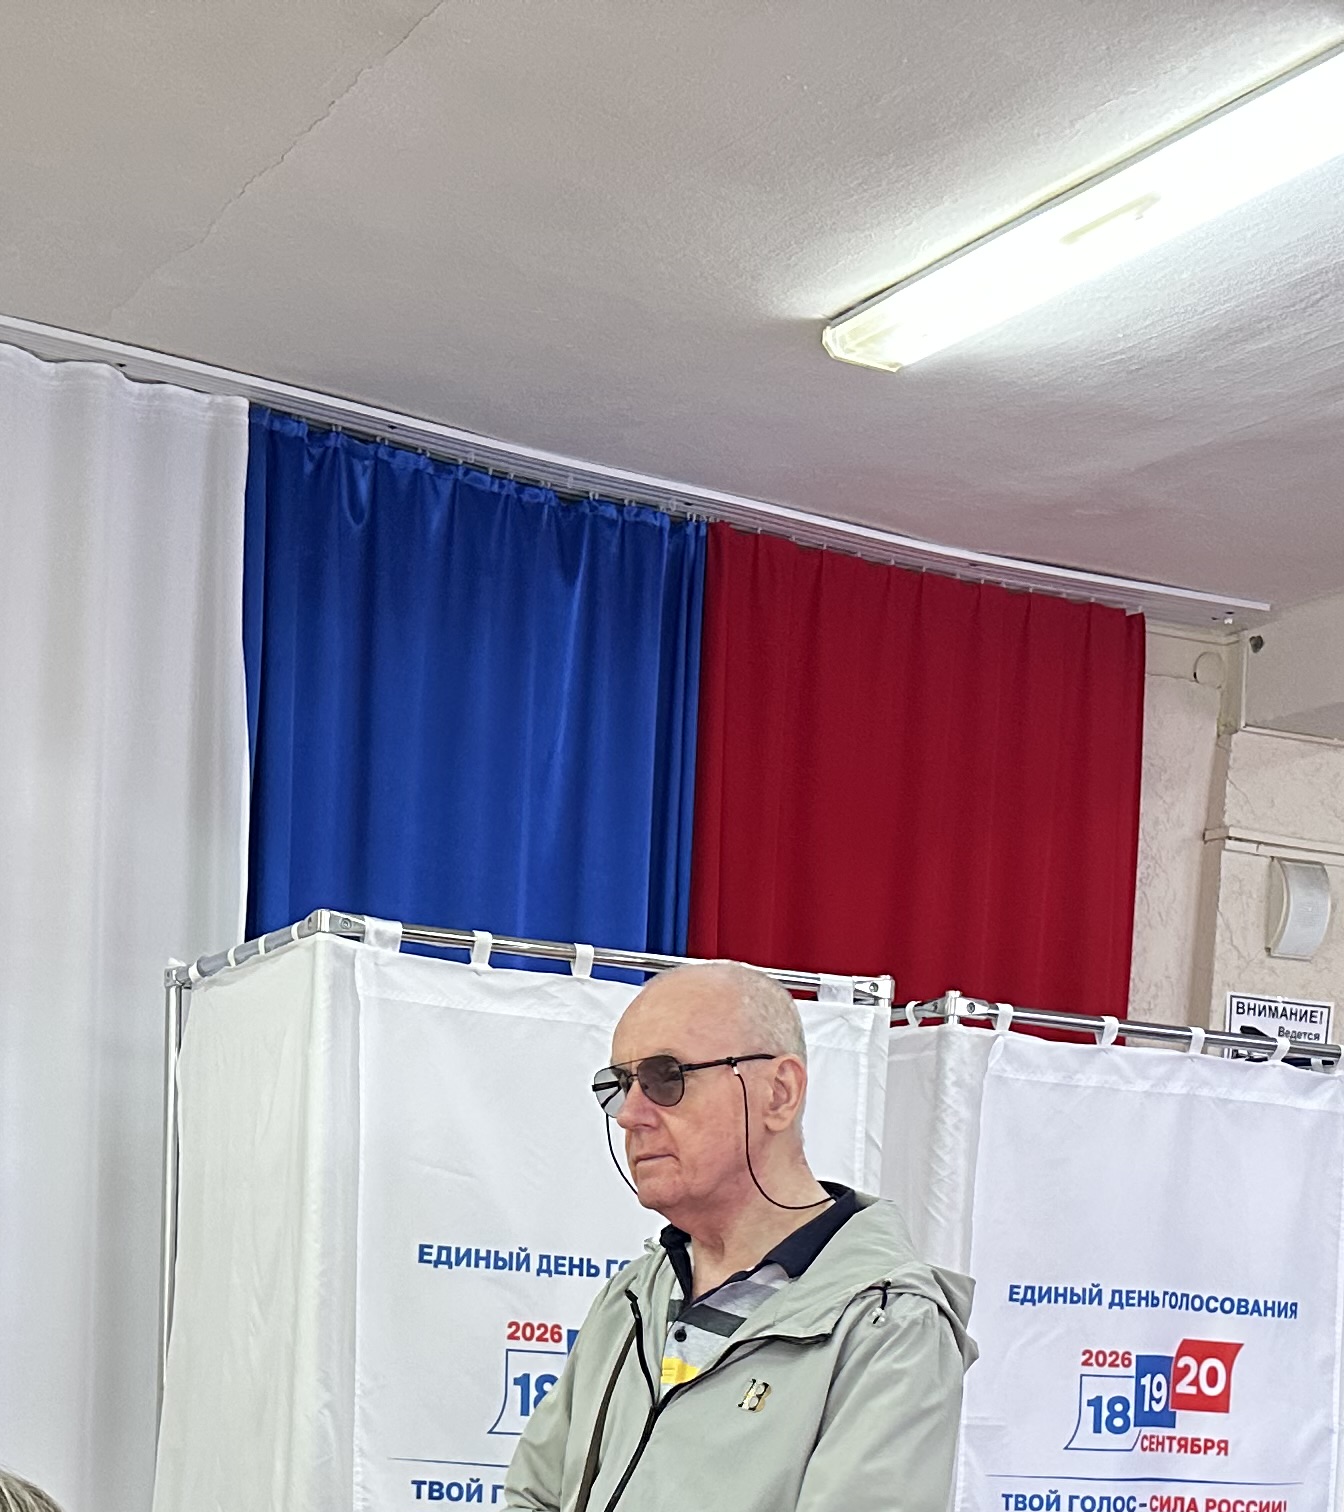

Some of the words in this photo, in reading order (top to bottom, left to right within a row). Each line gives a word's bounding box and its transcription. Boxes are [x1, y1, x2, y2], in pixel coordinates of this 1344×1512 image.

[1236, 1001, 1324, 1025] ВНИМАНИЕ!
[1278, 1026, 1320, 1041] Ведется
[418, 1243, 531, 1273] ЕДИНЫЙ
[536, 1254, 600, 1278] ДЕНЬ
[1008, 1283, 1103, 1306] ЕДИНЫЙ
[1108, 1288, 1160, 1310] ДЕНЬ
[1162, 1290, 1298, 1320] ГОЛОСОВАНИЯ
[507, 1321, 563, 1344] 2026
[1081, 1349, 1133, 1369] 2026
[1175, 1355, 1227, 1396] 20
[1141, 1373, 1168, 1413] 19
[1086, 1395, 1131, 1434] 18
[1140, 1434, 1229, 1457] СЕНТЯБРЯ
[411, 1478, 483, 1503] ТВОЙ
[1001, 1489, 1061, 1512] ТВОЙ
